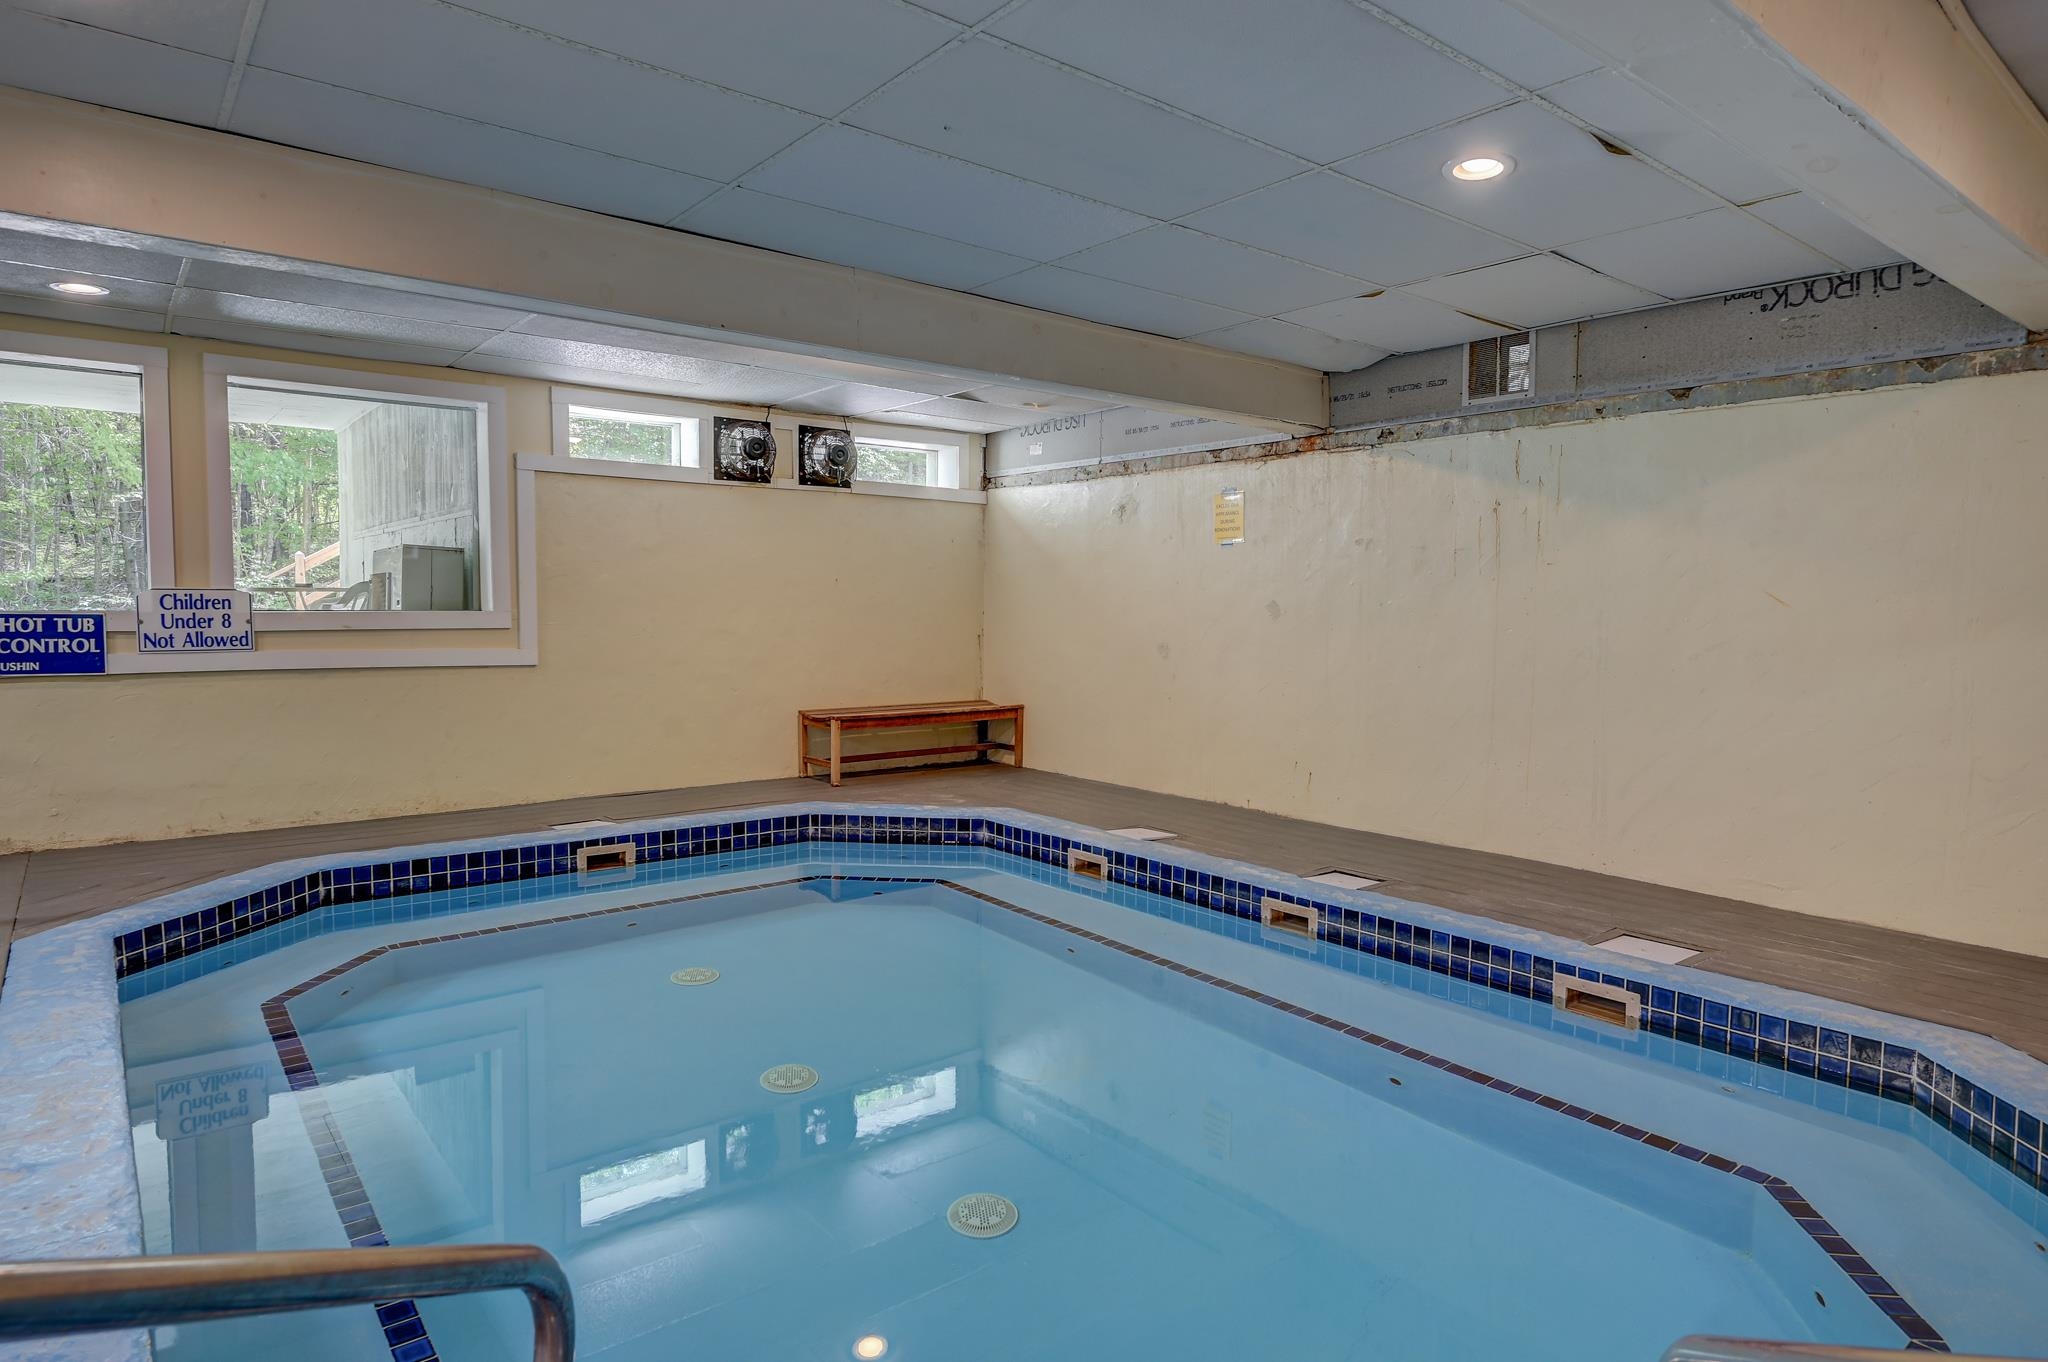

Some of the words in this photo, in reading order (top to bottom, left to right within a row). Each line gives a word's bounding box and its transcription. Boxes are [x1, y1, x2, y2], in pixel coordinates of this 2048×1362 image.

[159, 593, 232, 610] Children
[0, 617, 46, 632] HOT
[53, 617, 95, 633] TUB
[160, 613, 214, 629] Under
[222, 613, 232, 629] 8
[0, 637, 101, 653] CONTROL
[143, 632, 175, 648] Not
[182, 630, 249, 648] Allowed
